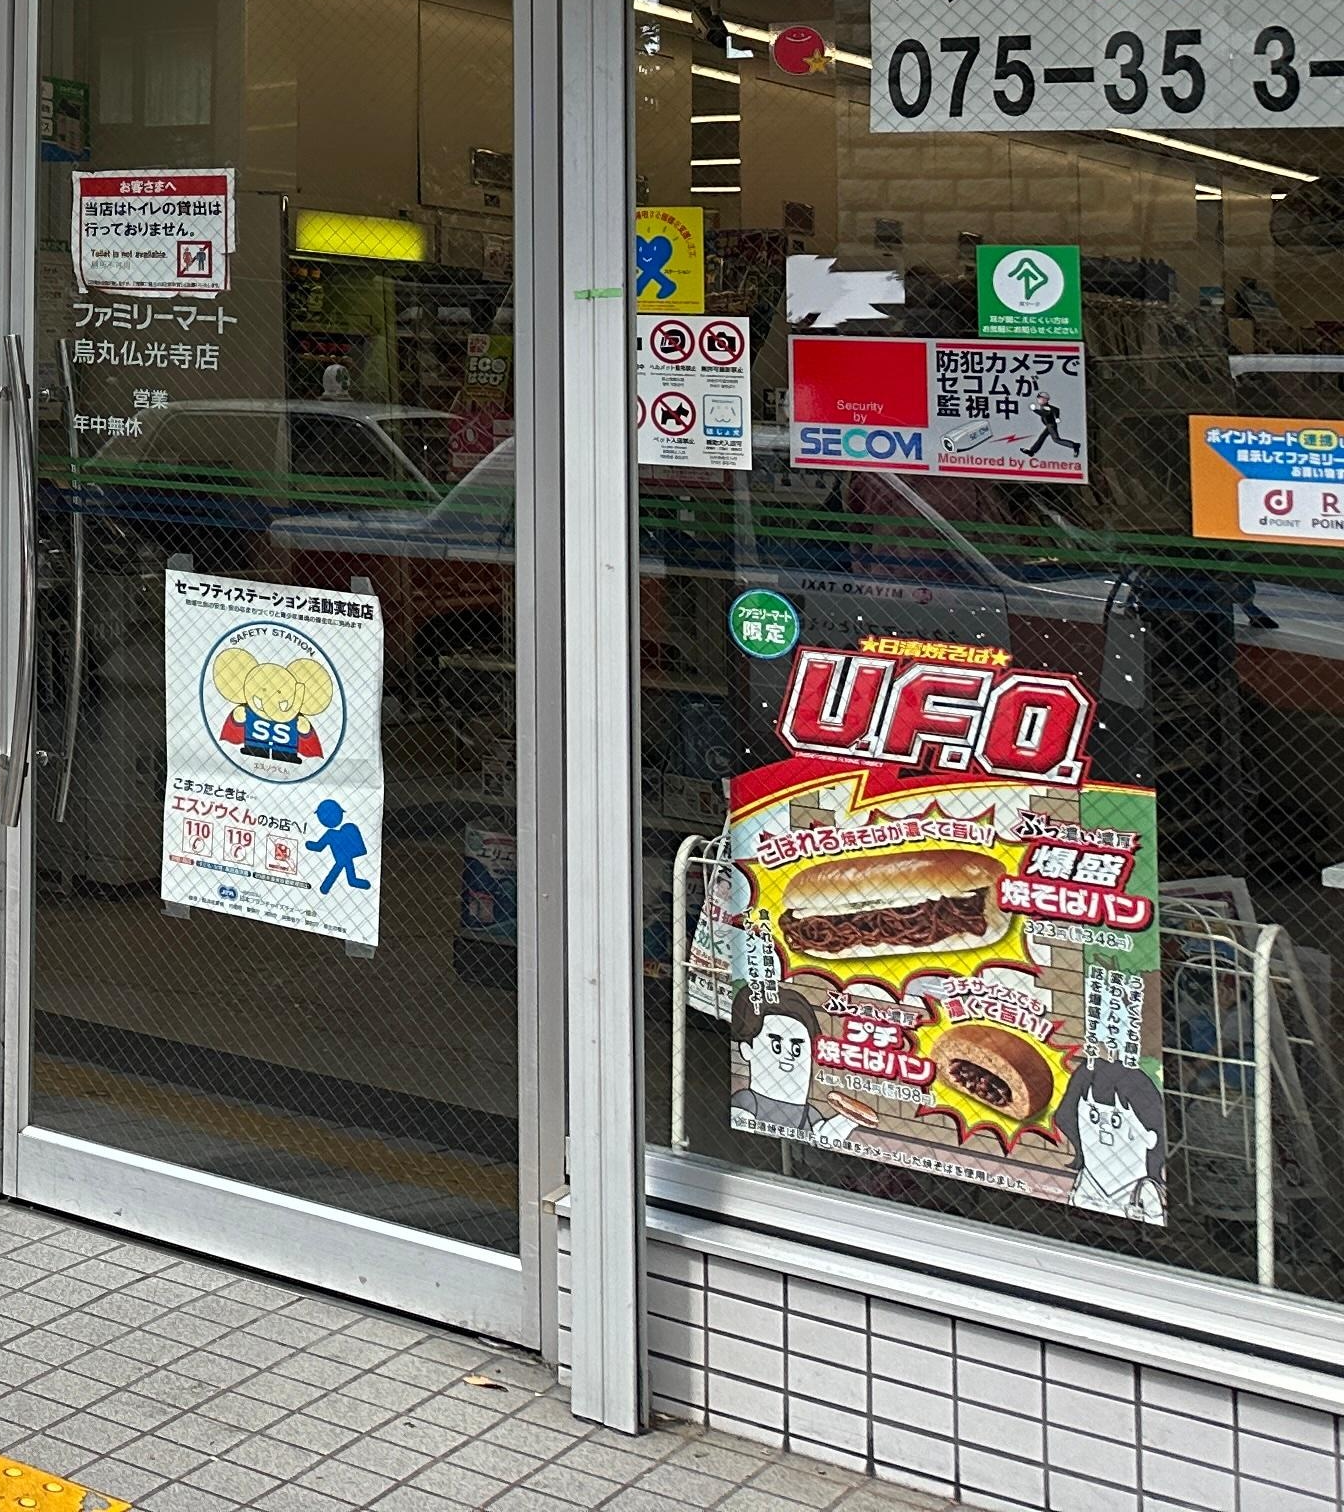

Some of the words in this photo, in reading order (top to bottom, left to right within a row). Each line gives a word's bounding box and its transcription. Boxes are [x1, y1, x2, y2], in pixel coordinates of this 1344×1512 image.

[118, 179, 177, 194] お客さまへ
[84, 201, 222, 217] 当店はトイレの貸出は
[84, 222, 196, 237] 行っておりません。
[91, 249, 111, 258] Toilet
[113, 249, 119, 258] is
[121, 249, 133, 258] not
[72, 302, 238, 335] ファミリーマート
[72, 338, 220, 371] 烏丸仏光寺店
[936, 350, 1080, 376] 防犯カメラで
[132, 388, 169, 409] 営業
[937, 375, 1039, 398] セコムが
[836, 399, 884, 413] Security
[853, 412, 867, 424] by
[937, 395, 1019, 420] 監視中
[73, 414, 143, 438] 年中無休
[800, 427, 922, 461] SECOM
[938, 453, 1004, 467] Monitored
[1008, 457, 1025, 471] by
[1029, 457, 1082, 471] Camera
[174, 580, 375, 621] セーフティステーション活動実施店
[737, 606, 793, 623] ファミリーマート
[229, 627, 269, 646] SAFETY
[271, 628, 316, 657] STATION
[742, 620, 787, 645] 限定
[253, 763, 291, 776] エスゾウくん
[184, 819, 211, 838] 110
[226, 829, 252, 847] 119
[1027, 844, 1127, 887] 爆盛
[999, 879, 1147, 924] 焼そばパン
[942, 976, 1046, 1016] プチサイズでも
[943, 996, 1053, 1041] 濃くて旨い!
[846, 1020, 898, 1047] プチ
[817, 1038, 932, 1081] 焼そばパン
